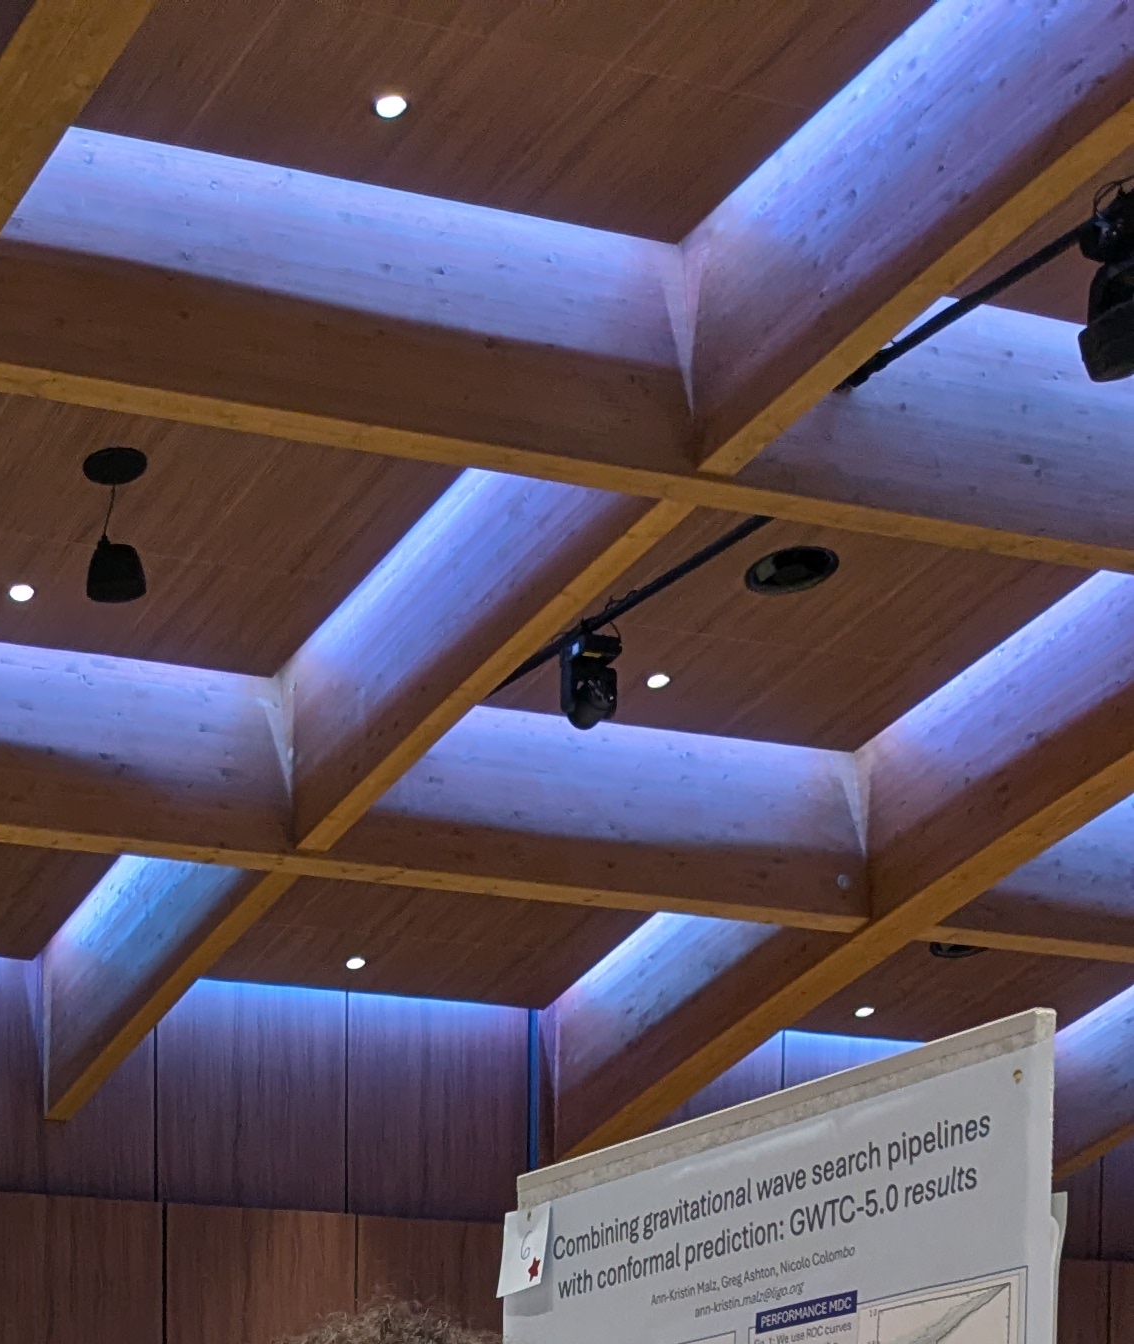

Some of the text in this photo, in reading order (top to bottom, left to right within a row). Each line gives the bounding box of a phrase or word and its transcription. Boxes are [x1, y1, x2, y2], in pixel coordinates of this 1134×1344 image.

[553, 1115, 990, 1260] Combining gravitational wave search pipelines
[558, 1166, 977, 1298] with conformal prediction: GWTC-5.0 results
[651, 1245, 856, 1306] Ann-Kristin Malz, Greg Ashton, Nicolo Colombo
[761, 1296, 852, 1328] PERFORMANCE MDC
